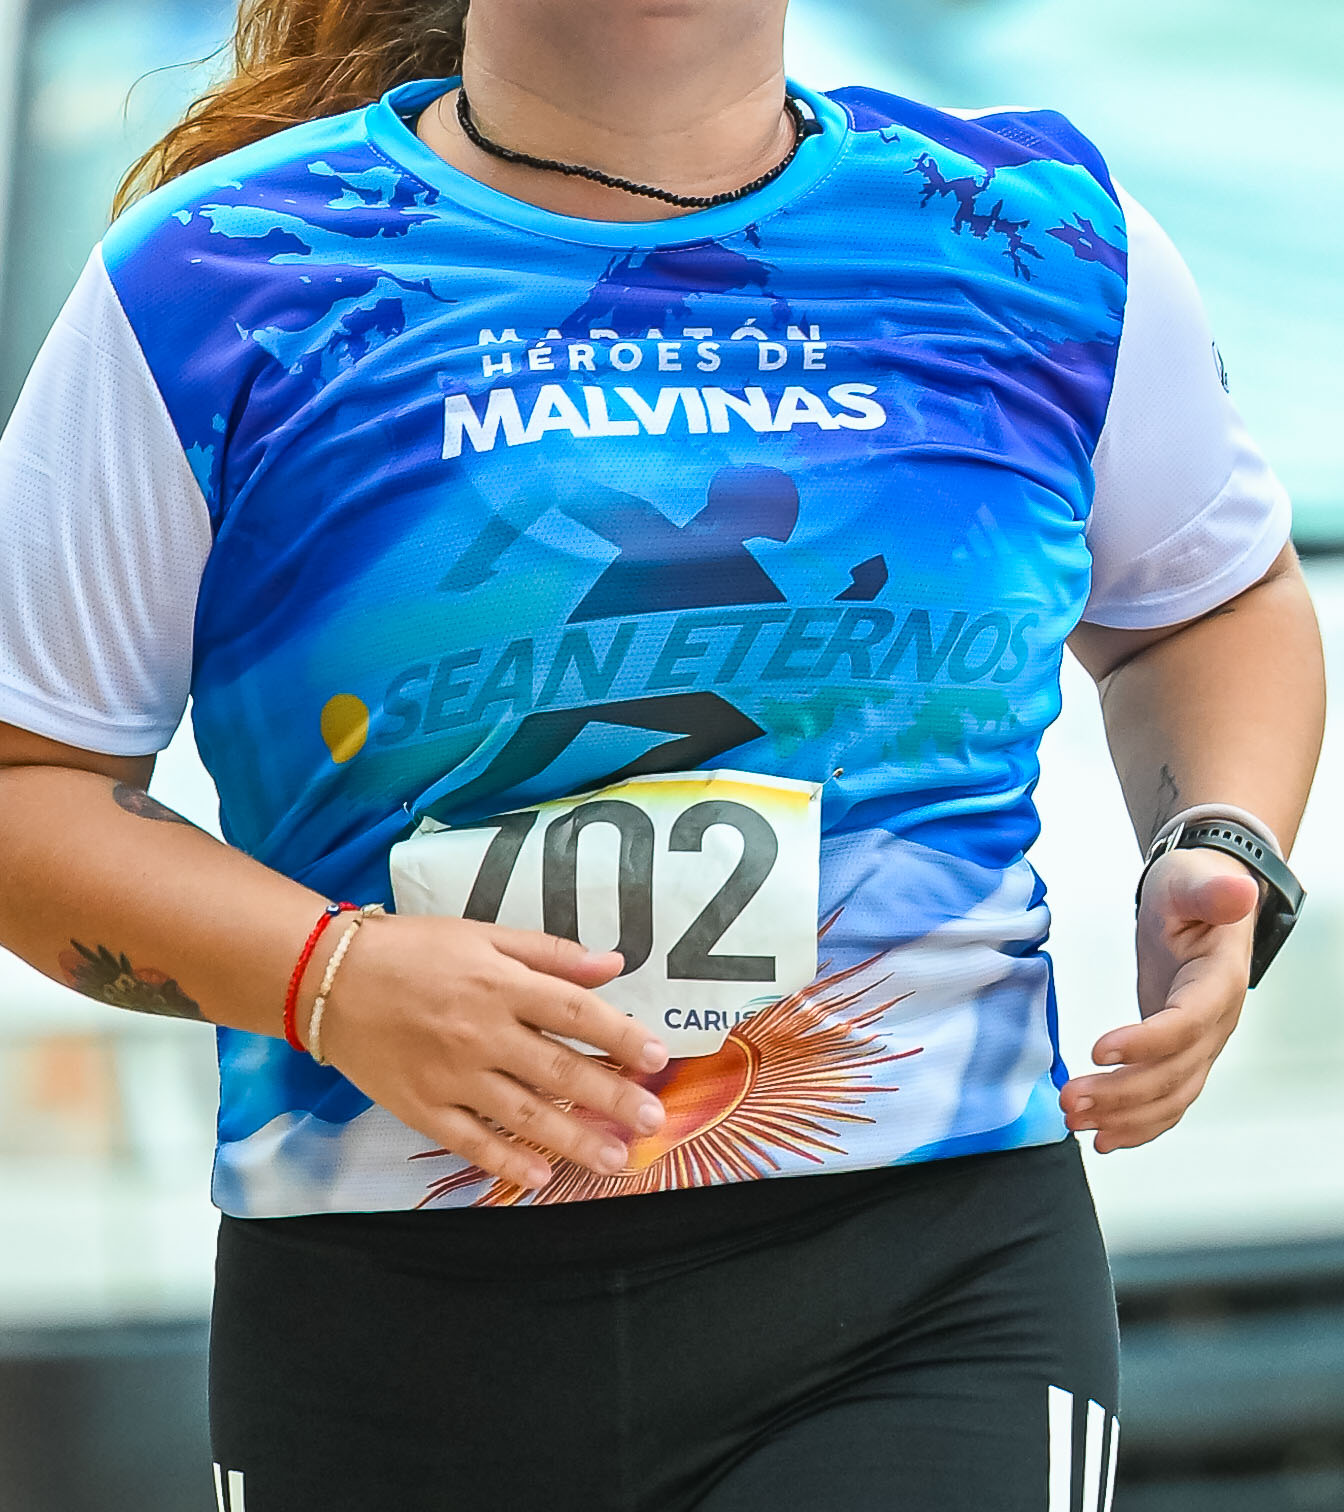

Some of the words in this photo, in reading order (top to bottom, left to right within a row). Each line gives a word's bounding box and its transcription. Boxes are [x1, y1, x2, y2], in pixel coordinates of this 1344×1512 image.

[482, 342, 722, 378] HÉROES
[757, 342, 828, 372] DE
[441, 383, 887, 460] MALVINAS
[375, 621, 639, 746] SEAN
[647, 606, 1039, 689] ETERNOS
[446, 799, 779, 983] 702
